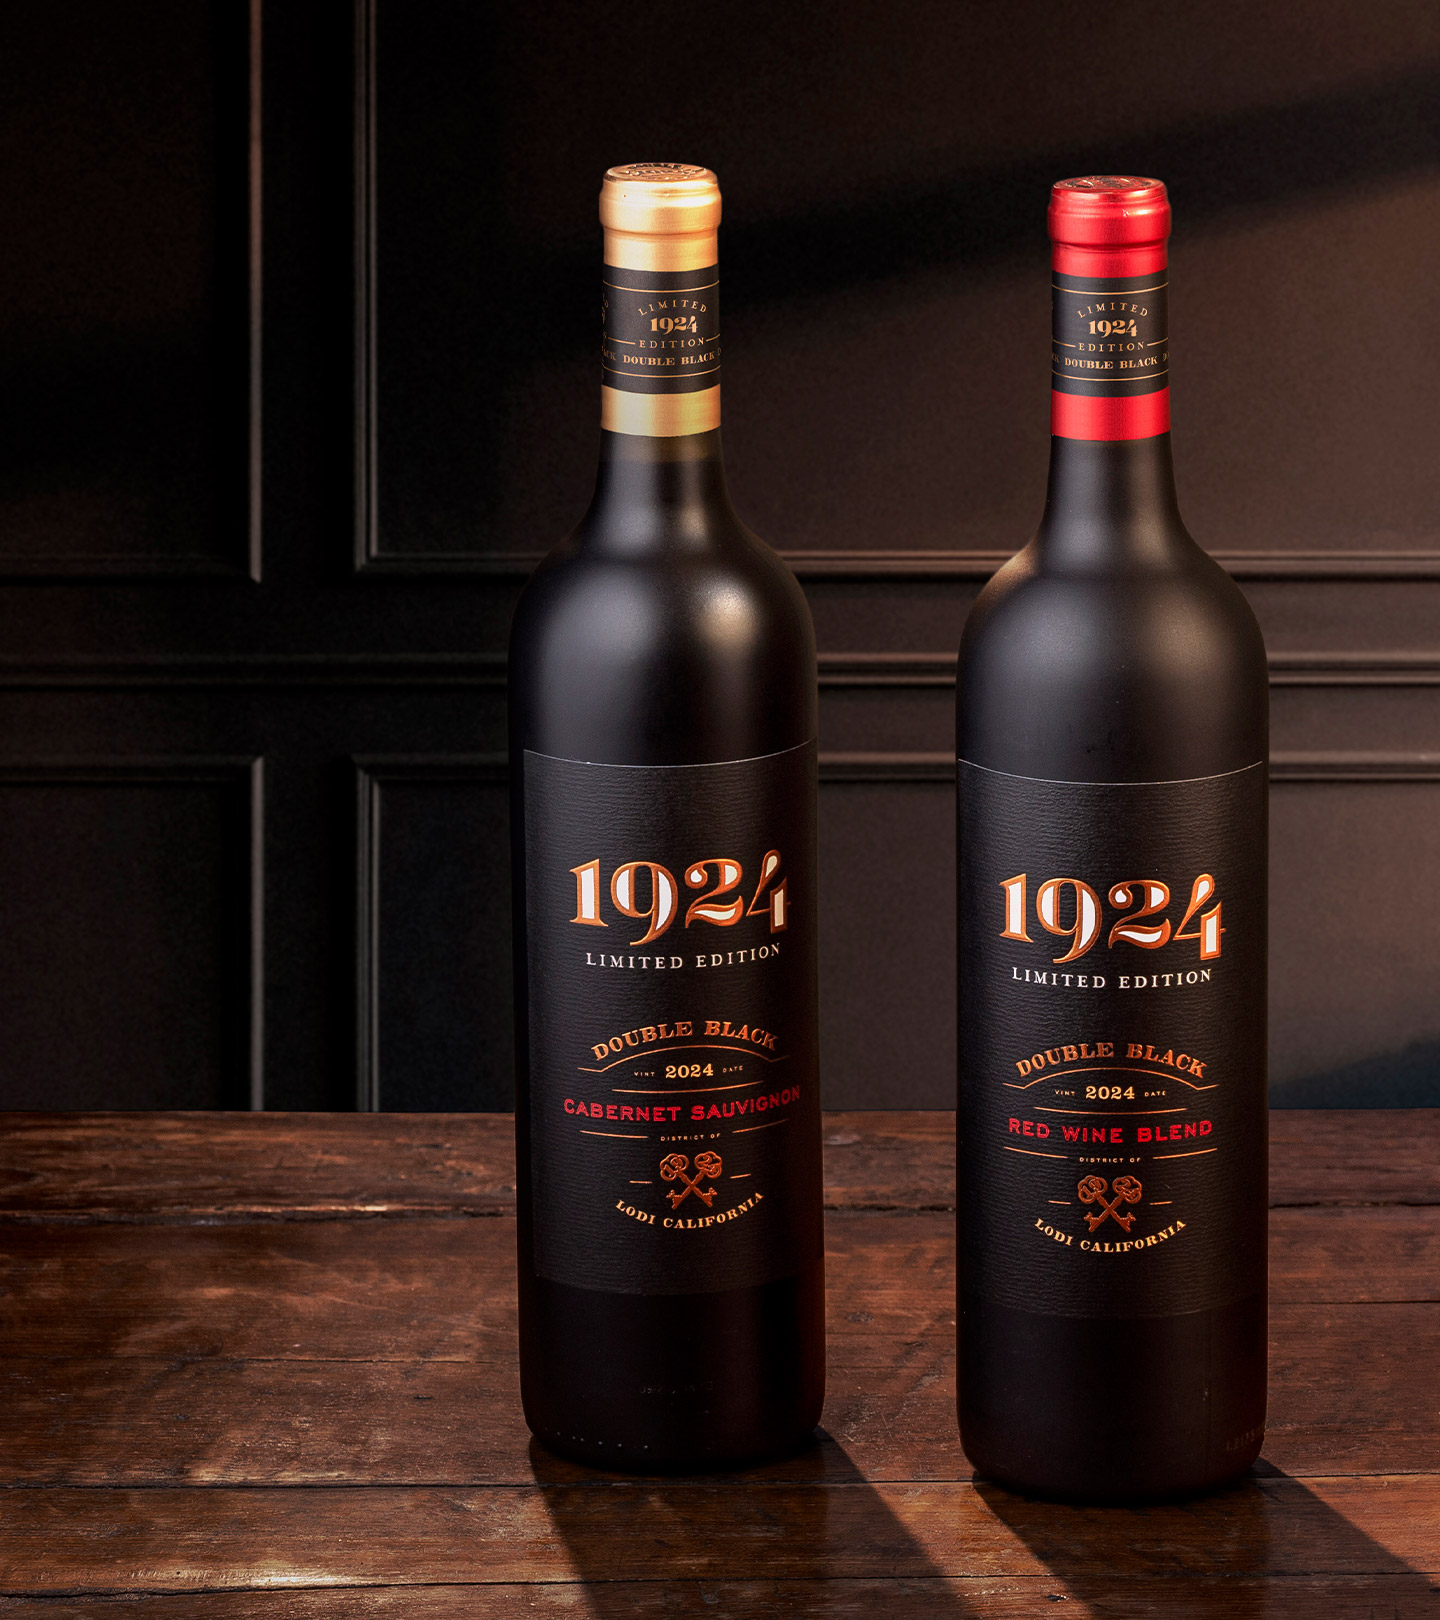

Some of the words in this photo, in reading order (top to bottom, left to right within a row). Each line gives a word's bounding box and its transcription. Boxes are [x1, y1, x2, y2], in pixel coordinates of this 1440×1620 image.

[638, 299, 708, 316] LIMITED
[1077, 302, 1149, 318] LIMITED
[650, 316, 698, 335] 1924
[1089, 319, 1137, 338] 1924
[640, 337, 705, 349] EDITION
[1079, 342, 1145, 352] EDITION
[623, 354, 675, 366] DOUBLE
[681, 352, 716, 365] BLACK
[1065, 358, 1114, 370] DOUBLE
[1120, 355, 1158, 368] BLACK
[569, 849, 792, 946] 1924
[999, 873, 1227, 964] 1924
[586, 952, 683, 969] LIMITED
[696, 942, 780, 969] EDITION
[1012, 967, 1106, 989] LIMITED
[1119, 969, 1213, 989] EDITION
[591, 1021, 693, 1061] DOUBLE
[705, 1020, 779, 1052] BLACK
[1016, 1042, 1115, 1078] DOUBLE
[1126, 1043, 1208, 1080] BLACK
[665, 1063, 715, 1079] 2024
[1085, 1085, 1135, 1100] 2024
[564, 1098, 681, 1122] CABERNET
[691, 1085, 801, 1121] SAUVIGNON
[660, 1134, 705, 1142] DISTRICT
[1008, 1117, 1051, 1139] RED
[1063, 1125, 1124, 1144] WINE
[1137, 1120, 1213, 1143] BLEND
[615, 1199, 655, 1225] LODI
[663, 1191, 764, 1229] CALIFORNIA
[1034, 1218, 1073, 1247] LODI
[1080, 1219, 1187, 1253] CALIFORNIA
